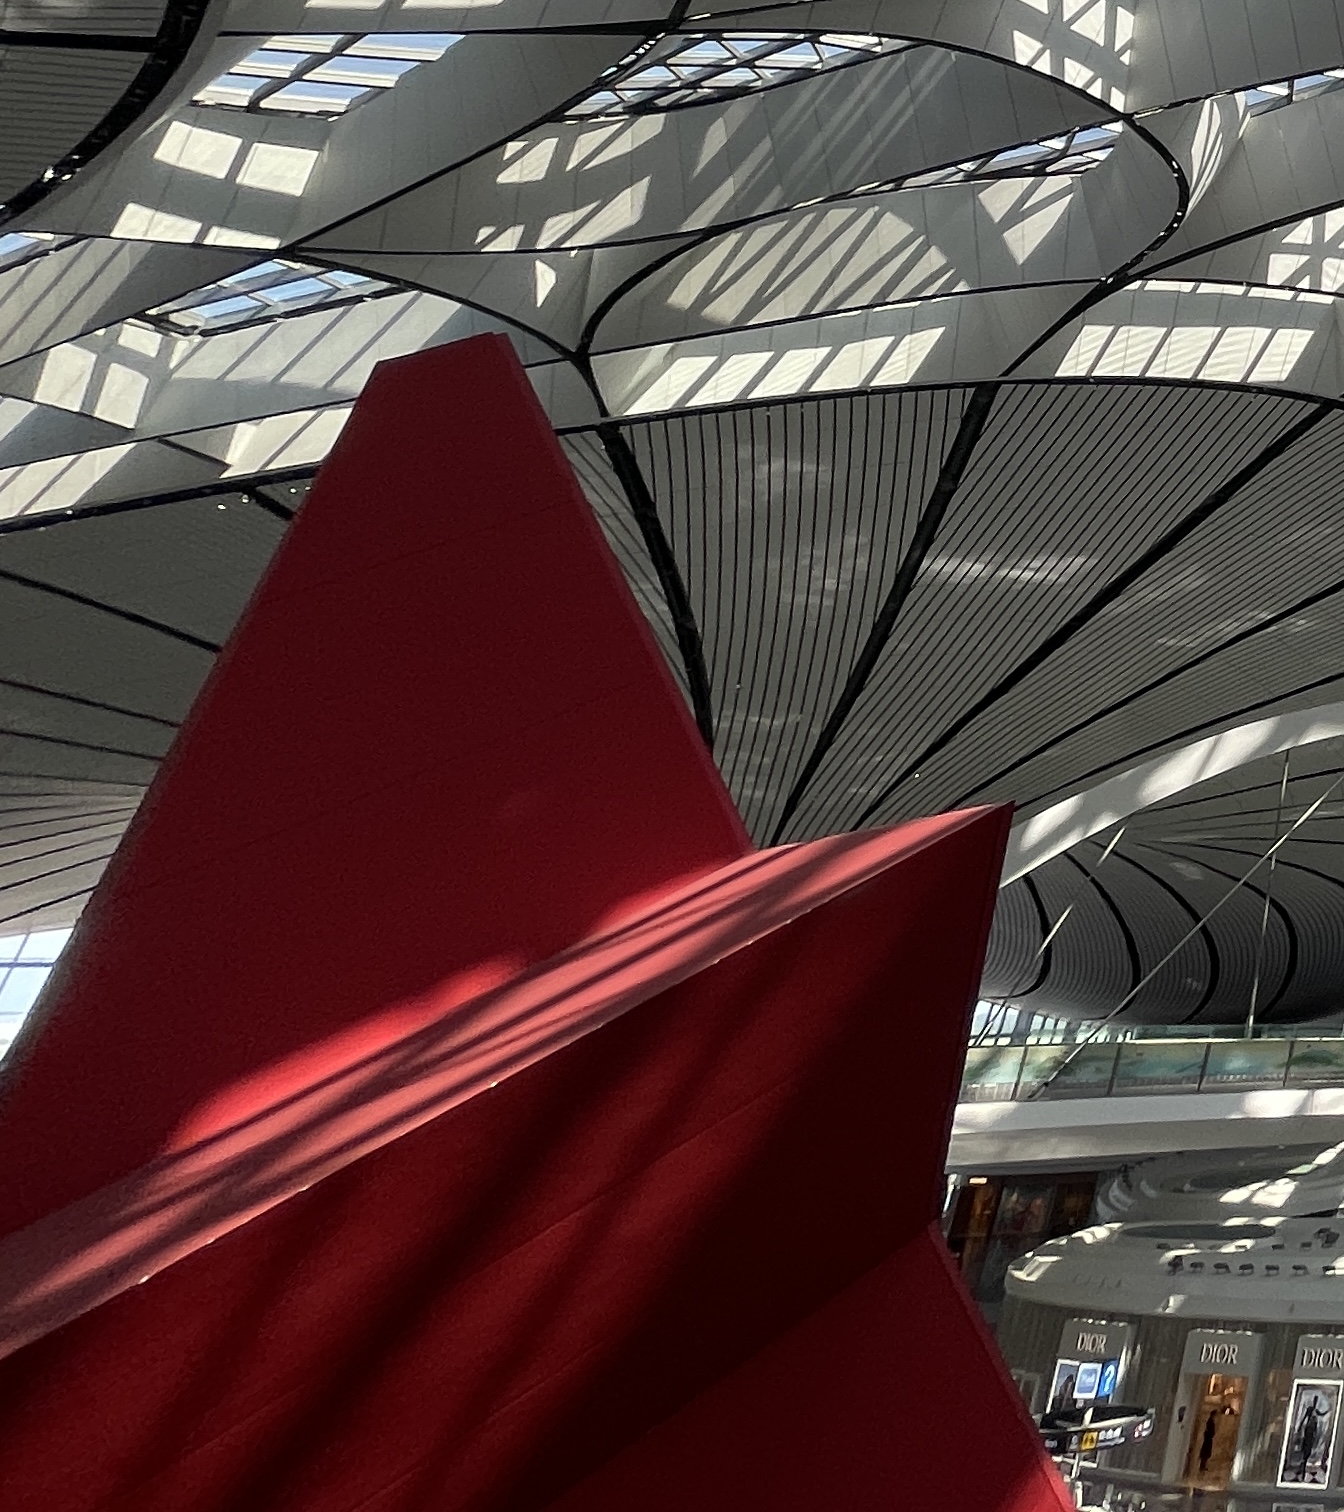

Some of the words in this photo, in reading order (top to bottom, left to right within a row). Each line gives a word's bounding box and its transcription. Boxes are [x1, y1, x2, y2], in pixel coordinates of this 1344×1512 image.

[1076, 1332, 1107, 1354] DIOR
[1200, 1342, 1239, 1365] DIOR
[1301, 1347, 1344, 1370] DIOR
